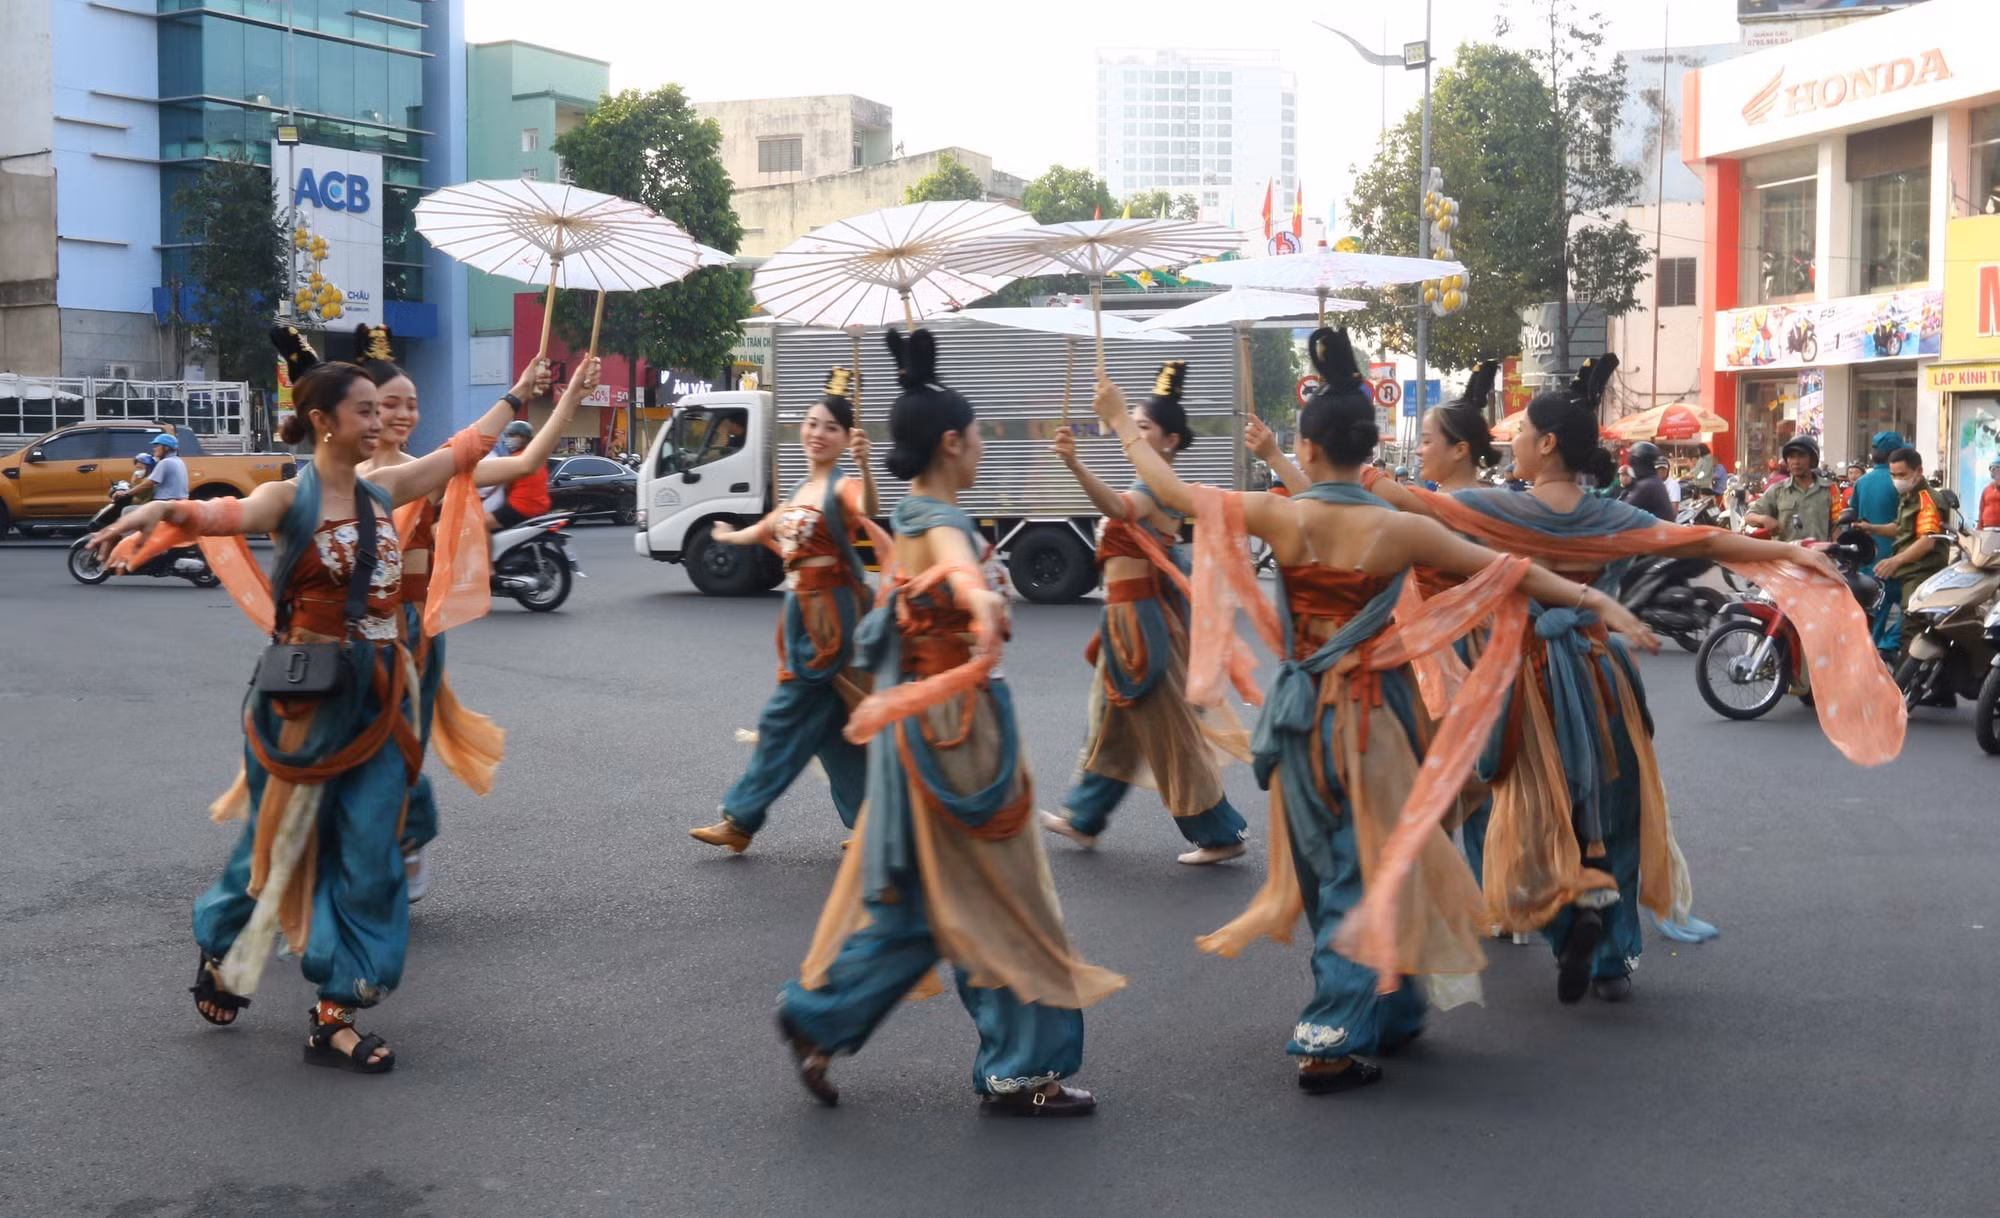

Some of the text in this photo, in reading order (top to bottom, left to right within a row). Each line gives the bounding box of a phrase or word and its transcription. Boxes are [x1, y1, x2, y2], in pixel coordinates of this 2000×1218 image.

[1784, 47, 1953, 117] HONDA
[295, 167, 370, 213] ACB
[673, 379, 688, 395] ĂN
[1958, 368, 1987, 385] KÍNH
